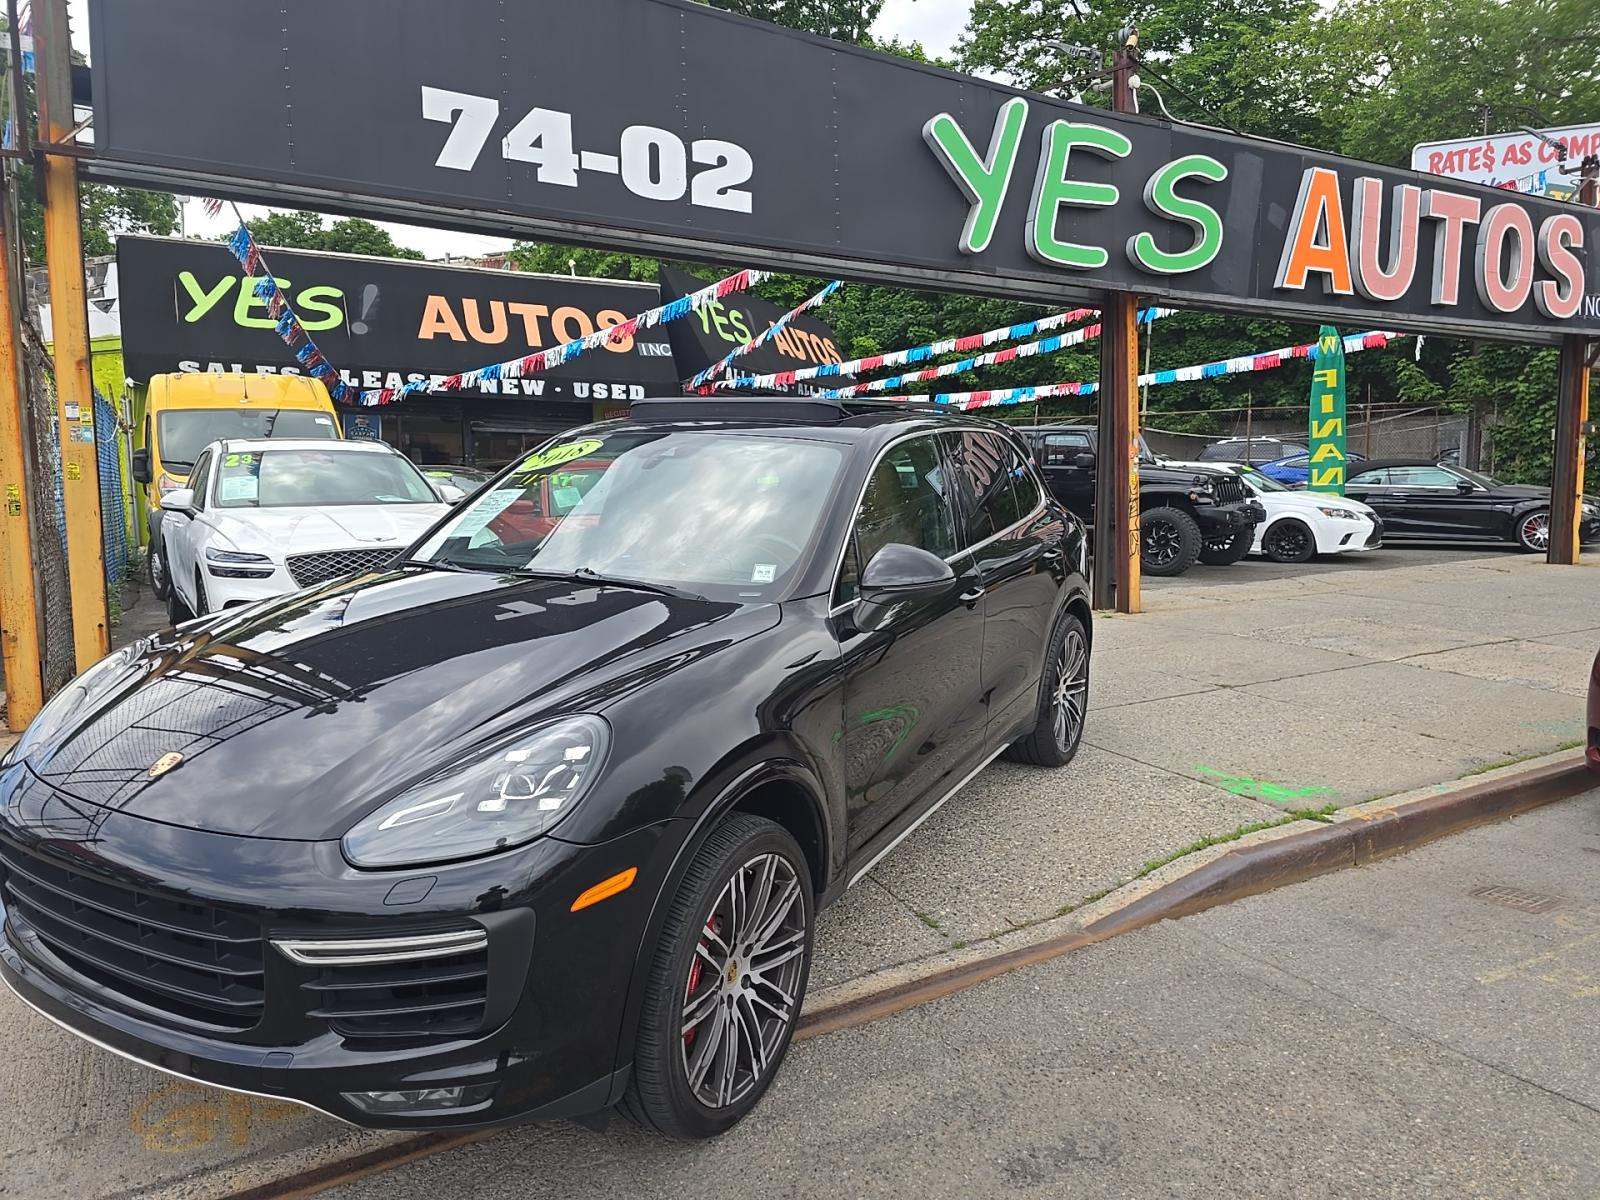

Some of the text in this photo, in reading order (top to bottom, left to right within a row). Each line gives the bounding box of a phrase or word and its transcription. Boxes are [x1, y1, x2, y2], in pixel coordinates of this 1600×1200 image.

[421, 85, 754, 214] 74-02
[1428, 140, 1496, 175] RATE$
[1502, 140, 1533, 166] AS
[922, 96, 1585, 319] YES AUTOS
[418, 294, 635, 354] AUTOS
[694, 297, 752, 346] YES
[768, 320, 843, 364] AUTOS
[480, 378, 545, 396] NEW
[573, 382, 645, 400] USED
